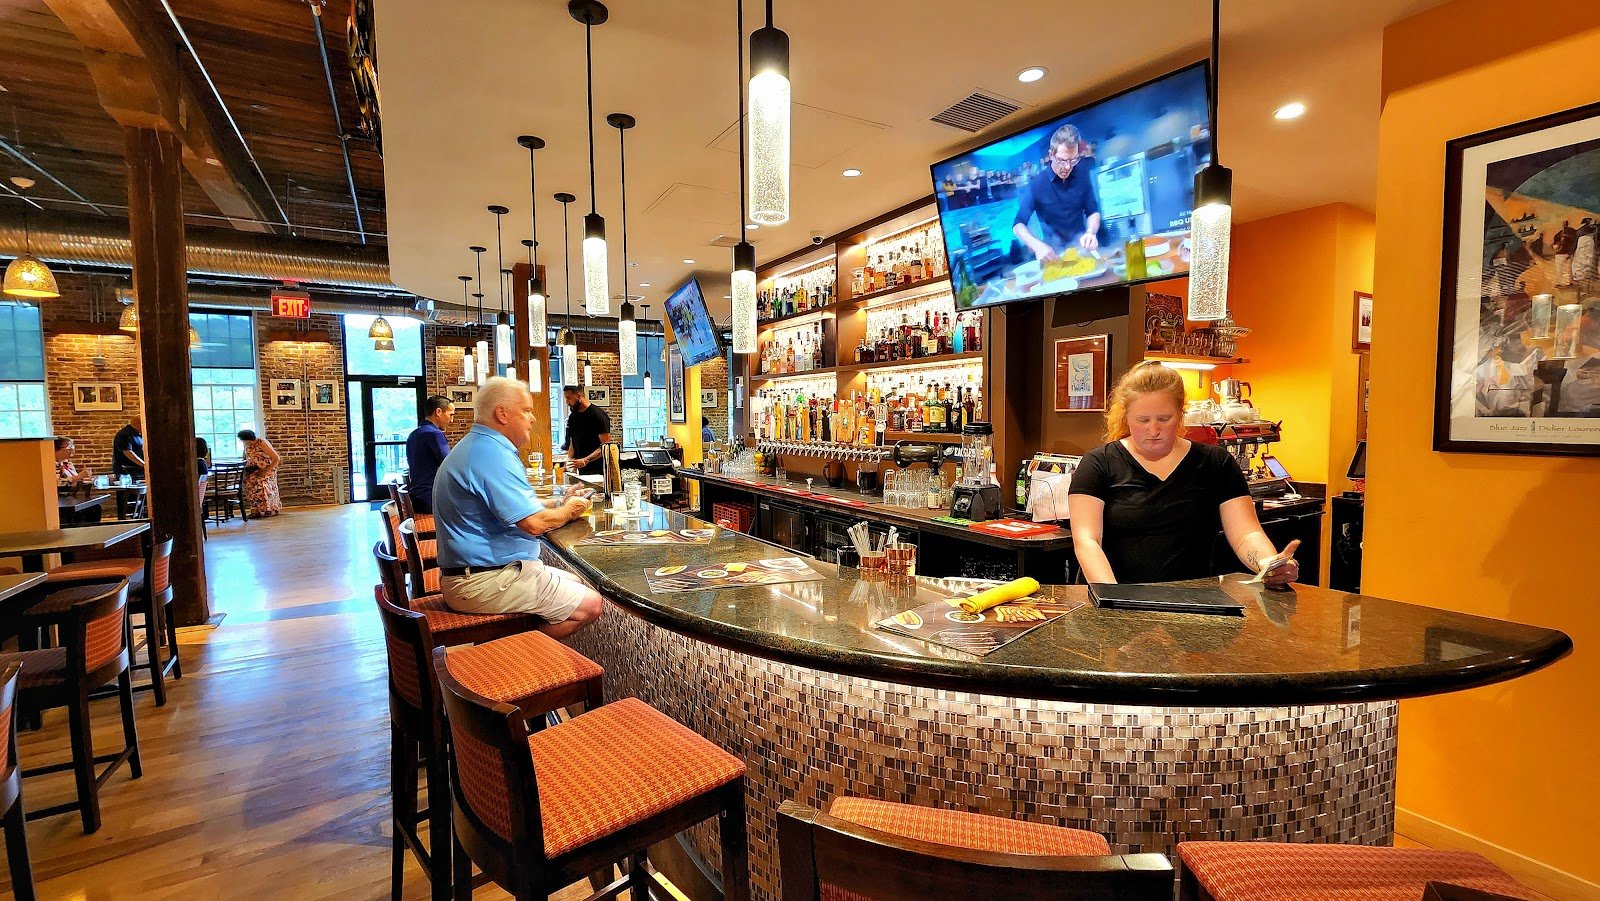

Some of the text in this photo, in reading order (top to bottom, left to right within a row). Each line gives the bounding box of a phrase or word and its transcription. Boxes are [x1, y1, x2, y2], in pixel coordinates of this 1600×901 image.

[1169, 218, 1184, 227] BBQ
[278, 298, 305, 317] EXIT
[1489, 423, 1508, 431] Blue
[1538, 424, 1565, 432] Didier
